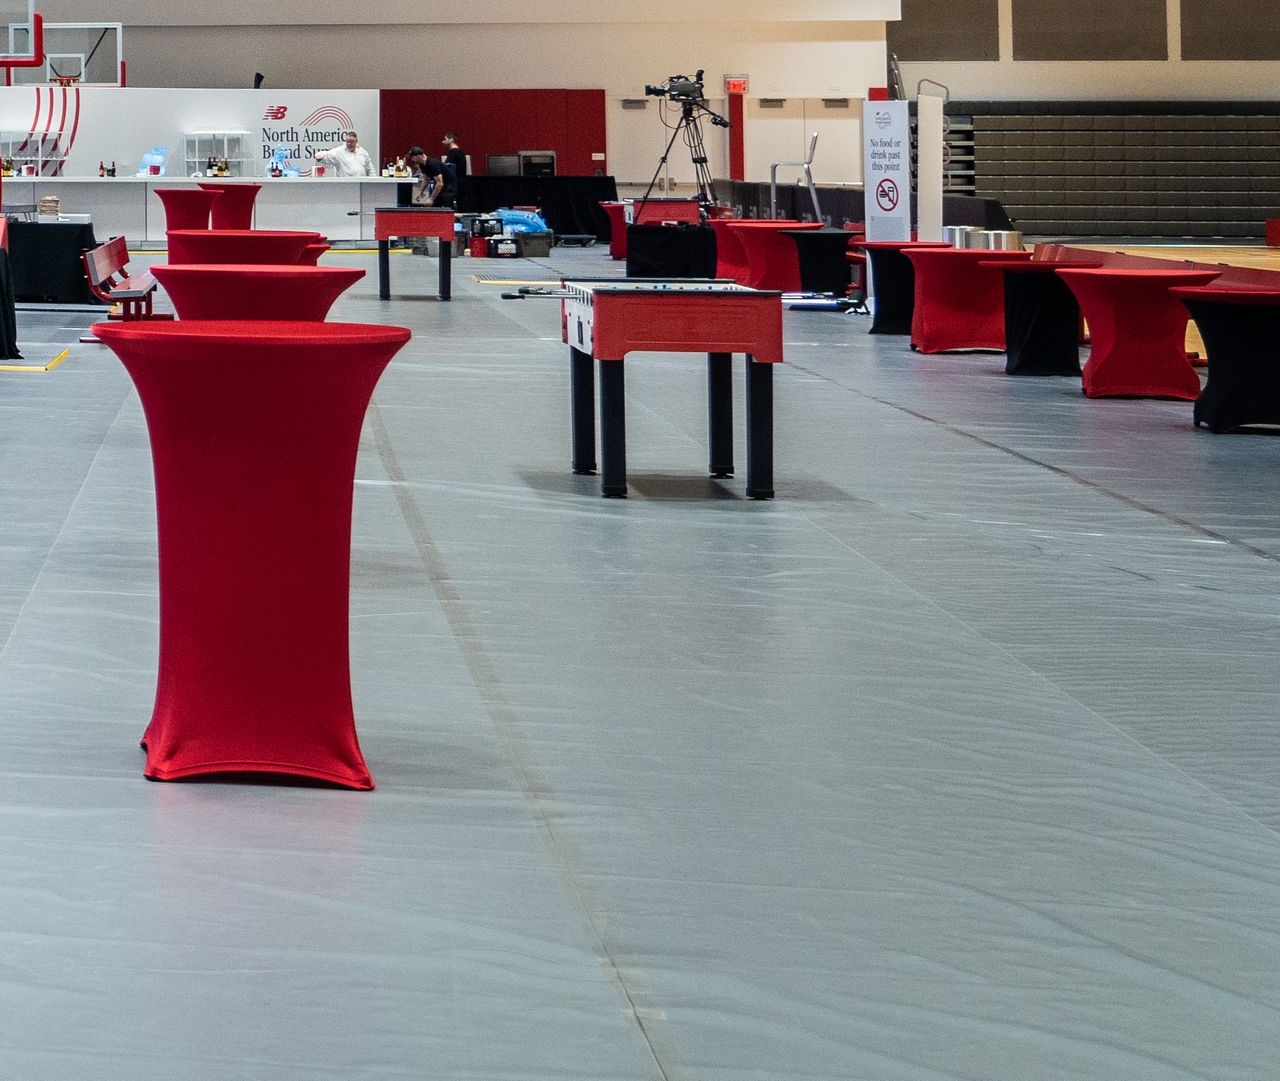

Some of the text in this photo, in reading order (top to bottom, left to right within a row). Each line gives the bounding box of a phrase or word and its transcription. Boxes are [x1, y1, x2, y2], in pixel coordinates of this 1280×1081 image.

[262, 127, 348, 142] North Americ
[880, 137, 893, 148] food
[894, 140, 901, 148] or
[870, 150, 901, 162] drink past
[884, 161, 900, 174] point
